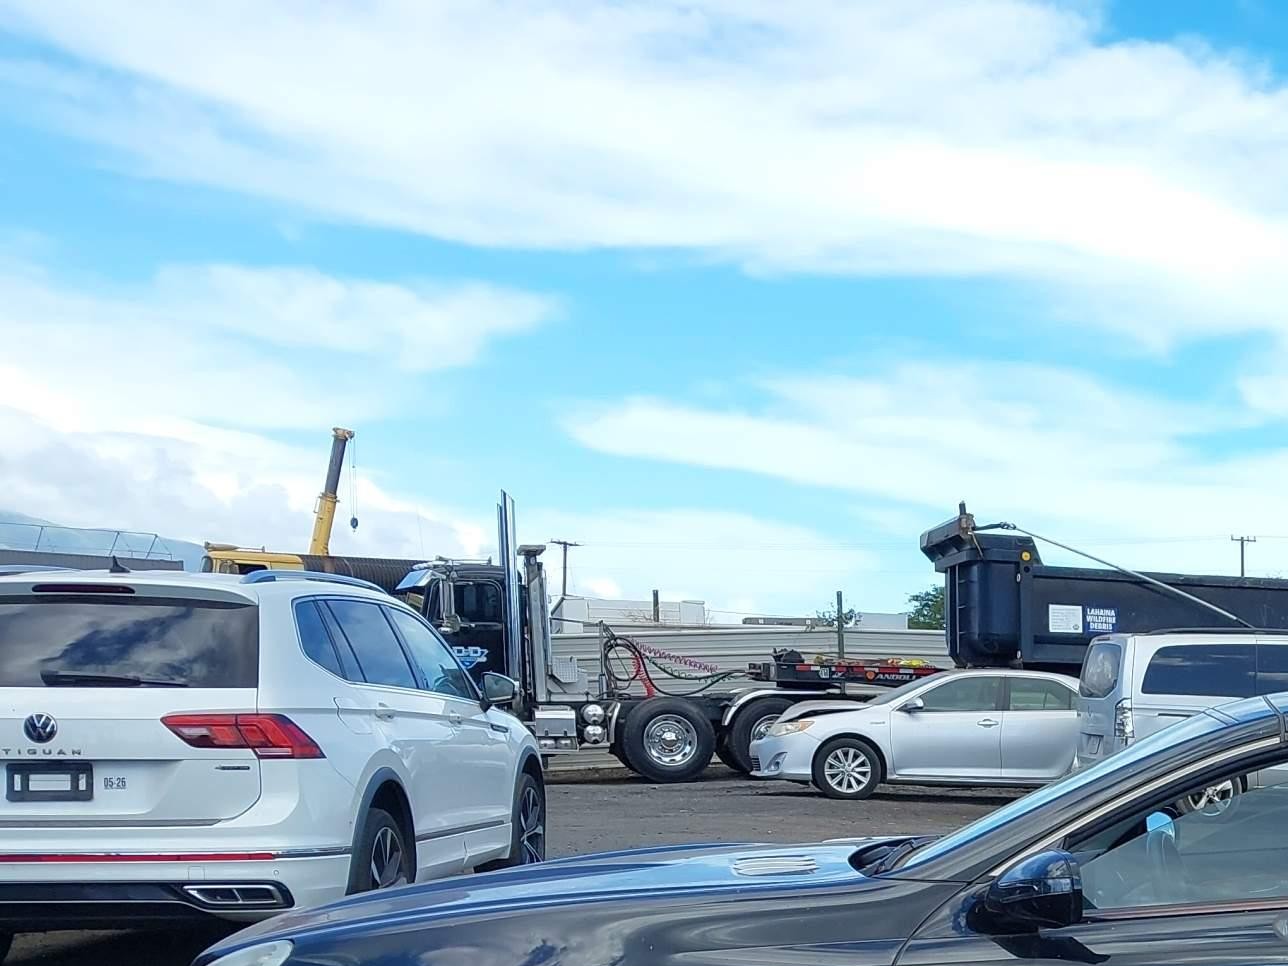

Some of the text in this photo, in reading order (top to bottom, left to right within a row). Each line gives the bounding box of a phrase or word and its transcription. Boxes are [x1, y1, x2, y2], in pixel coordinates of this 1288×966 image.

[1087, 608, 1115, 616] LAHAINA
[1086, 615, 1116, 623] WILDFIRE
[1, 748, 82, 756] TIGUAN
[103, 777, 127, 788] 05-26
